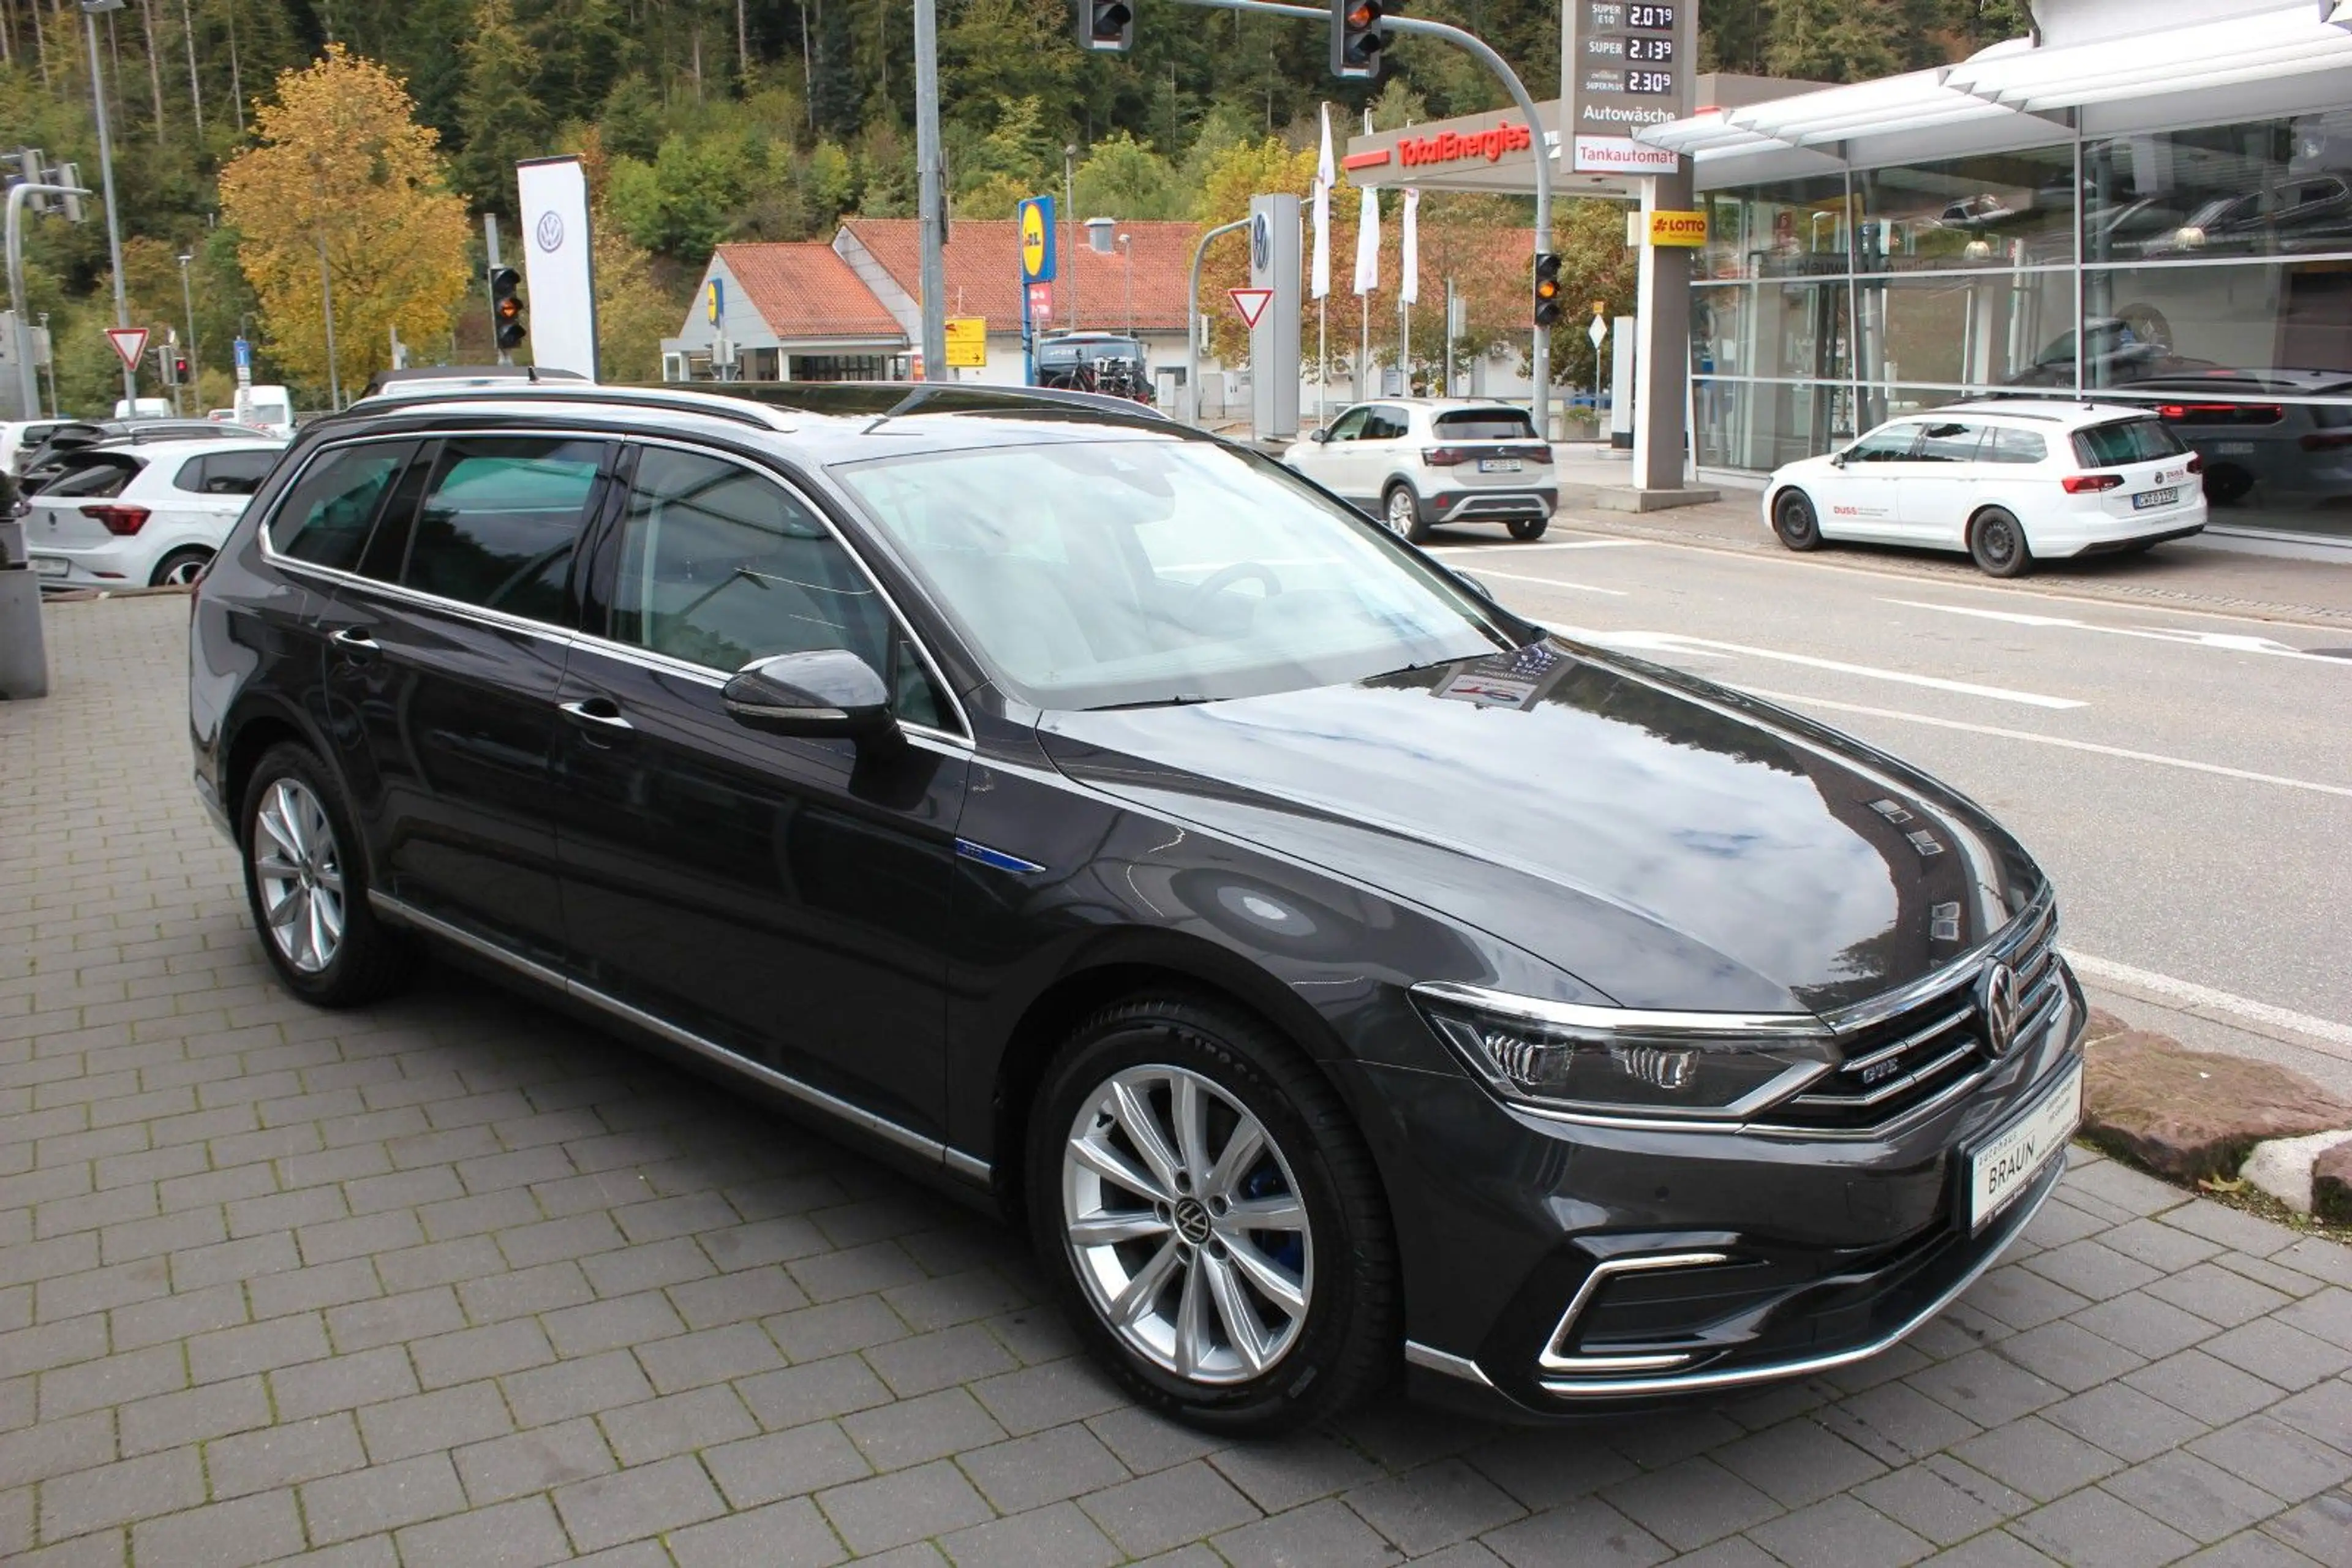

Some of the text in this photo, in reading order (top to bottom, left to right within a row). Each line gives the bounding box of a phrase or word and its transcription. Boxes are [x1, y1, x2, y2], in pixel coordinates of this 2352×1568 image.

[1592, 3, 1621, 15] SUPER
[1597, 14, 1615, 24] E10
[1588, 40, 1623, 55] SUPER
[1582, 104, 1676, 123] Autowäsche
[1397, 120, 1530, 164] TotalEnergies
[1580, 146, 1675, 165] Tankautomat
[1668, 218, 1706, 232] LOTTO
[1988, 1134, 2035, 1195] BRAUN
